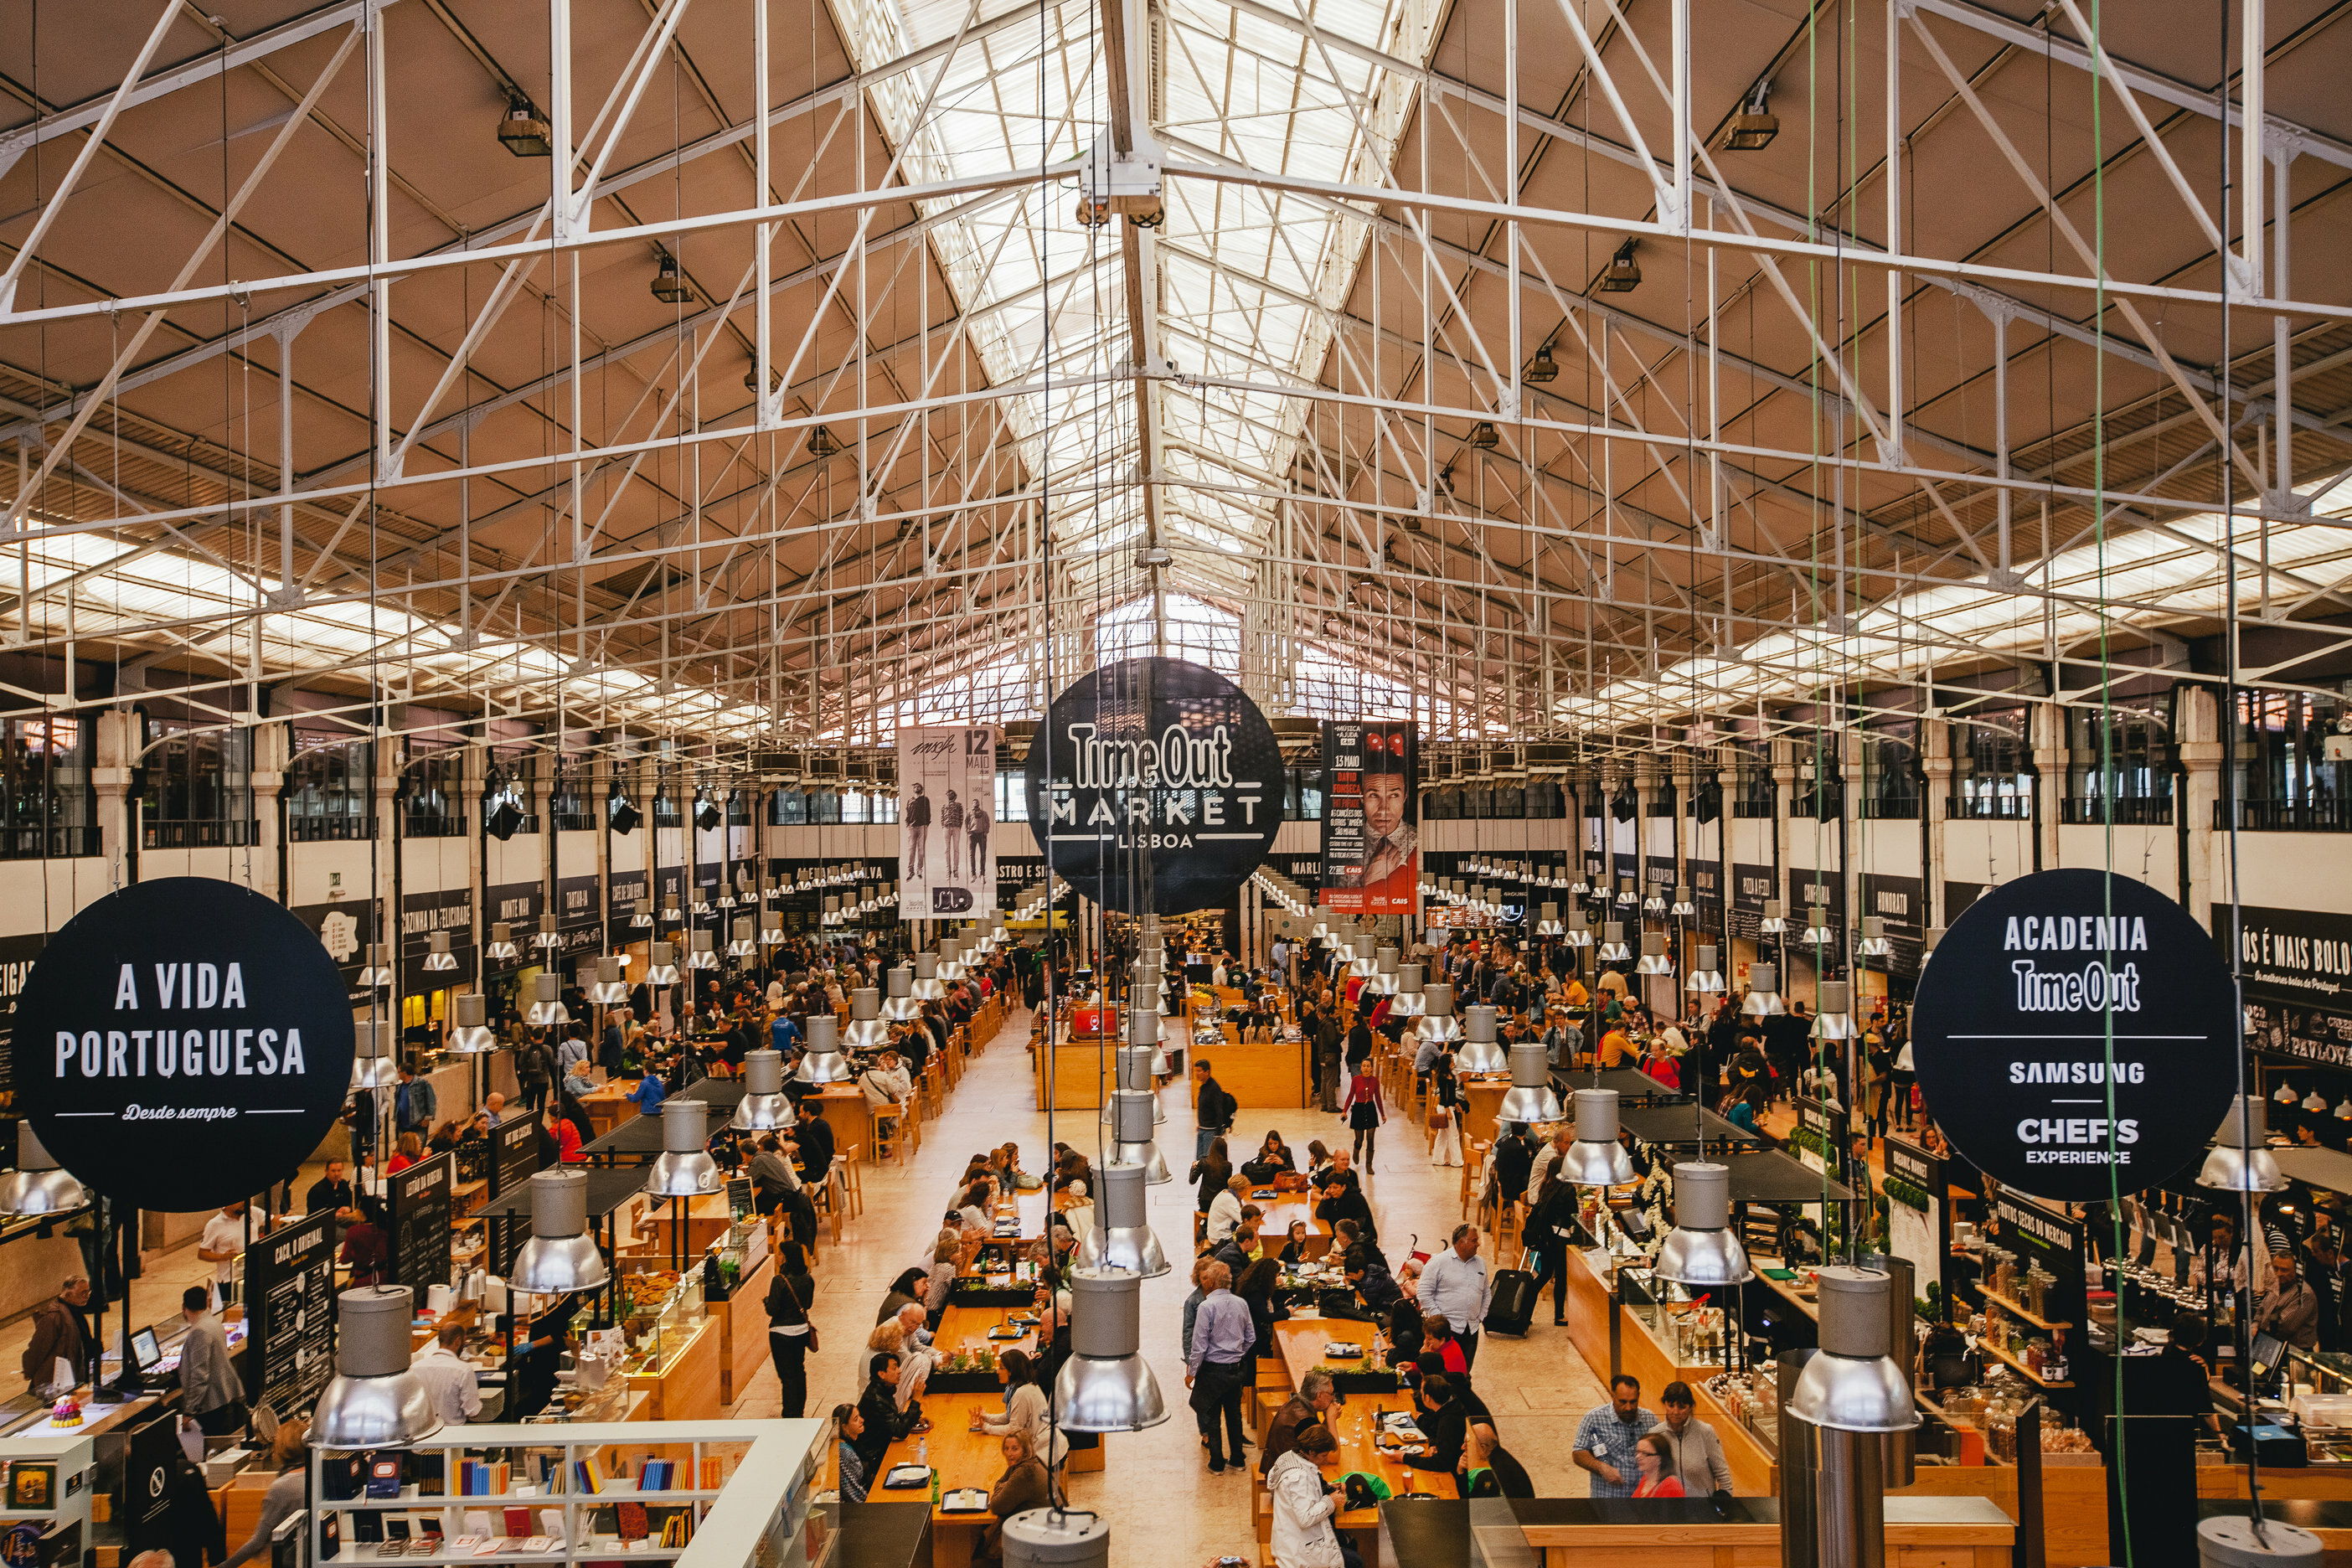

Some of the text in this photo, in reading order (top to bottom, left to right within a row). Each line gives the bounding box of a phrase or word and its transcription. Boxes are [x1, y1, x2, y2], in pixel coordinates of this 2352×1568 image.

[965, 730, 988, 755] 12
[967, 756, 989, 769] MAIO
[1335, 755, 1359, 767] 13 MAIO
[1333, 783, 1361, 793] FONSECA
[1337, 772, 1357, 781] DAVID
[1049, 797, 1261, 826] MARKET
[1118, 834, 1194, 848] LISBOA
[1877, 891, 1907, 916] HONORATO
[402, 905, 470, 935] COZINHA DA FELICIDADE
[2004, 916, 2148, 951] ACADEMIA
[2262, 927, 2271, 965] É
[2274, 935, 2309, 970] MAIS
[2313, 939, 2352, 976] BOLO
[115, 962, 246, 1010] A VIDA
[2288, 976, 2303, 988] bolos
[2303, 978, 2311, 989] de
[2312, 977, 2339, 995] Portugal
[55, 1028, 306, 1078] PORTUGUESA
[2009, 1062, 2144, 1084] SAMSUNG
[122, 1103, 238, 1122] Desde sempre
[2017, 1118, 2139, 1144] CHEF'S
[1893, 1150, 1911, 1171] ORGANIC
[1911, 1158, 1927, 1179] MARKET
[2026, 1151, 2131, 1164] EXPERIENCE
[1998, 1200, 2018, 1224] FRUTOS
[2018, 1210, 2035, 1233] SECOS
[2036, 1218, 2044, 1237] DO
[2045, 1222, 2072, 1251] MERCADO
